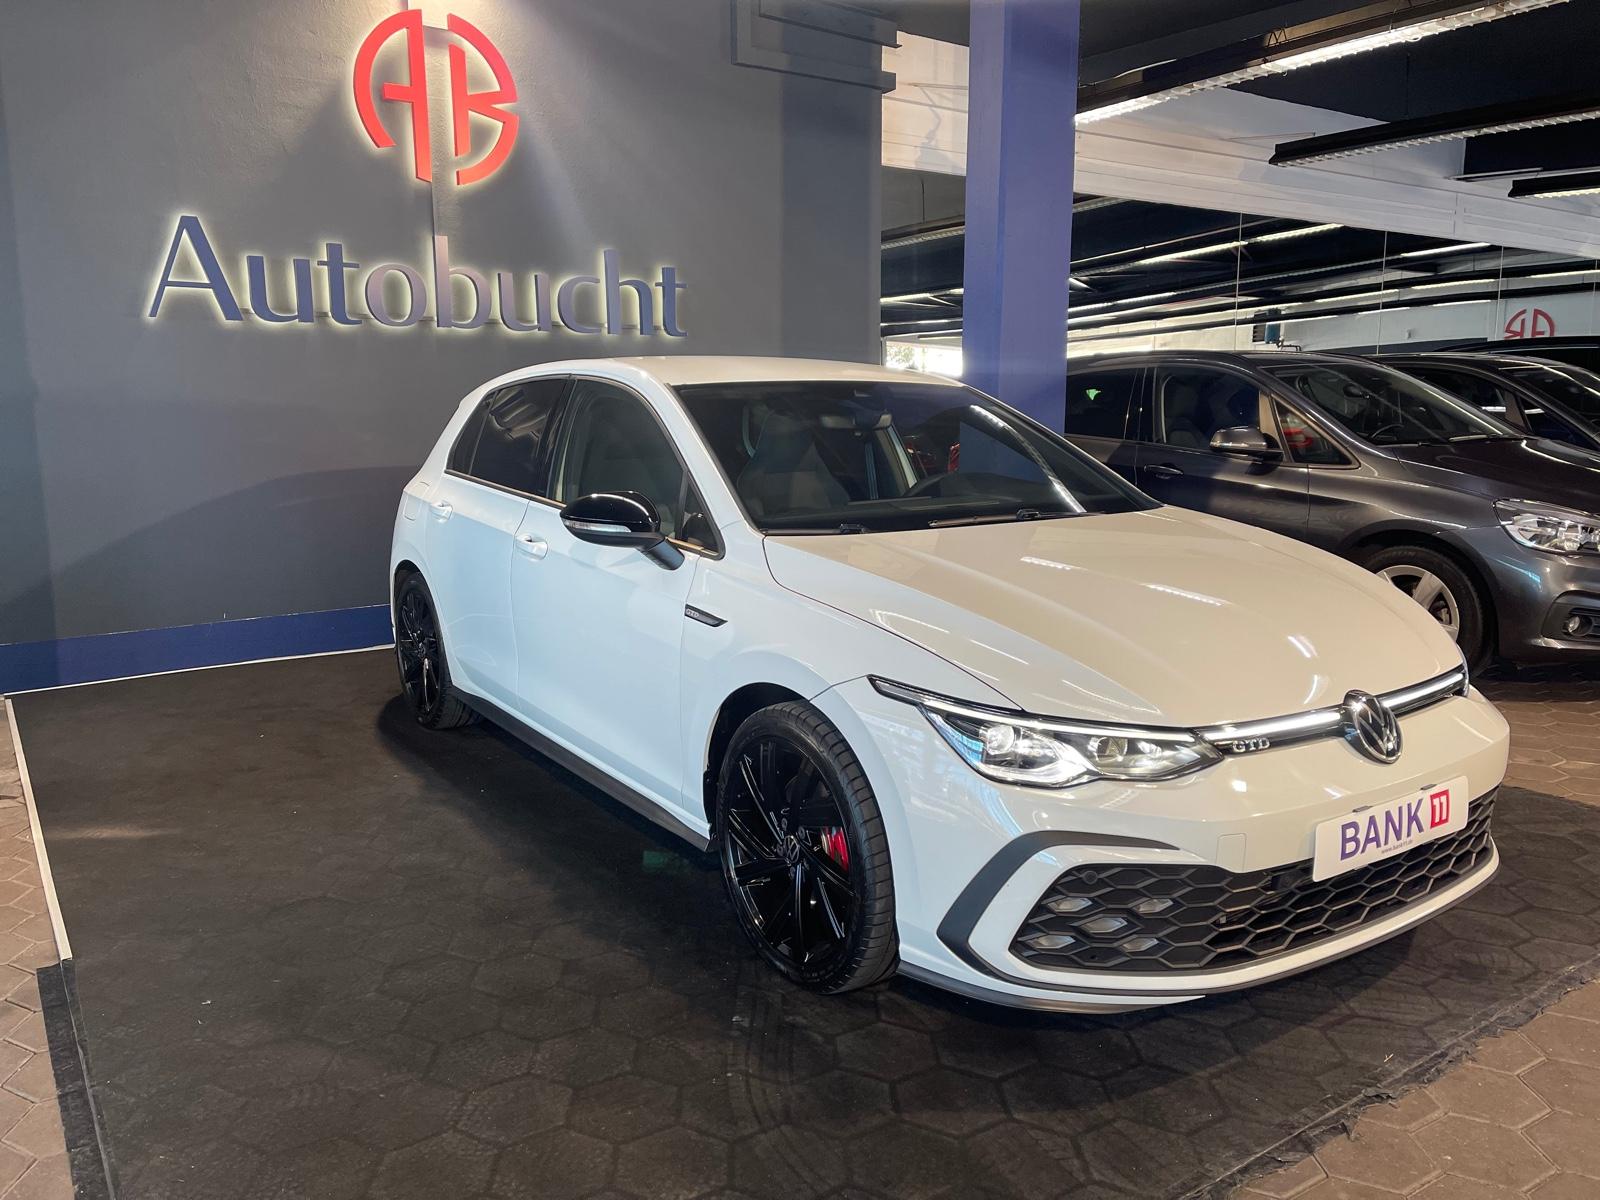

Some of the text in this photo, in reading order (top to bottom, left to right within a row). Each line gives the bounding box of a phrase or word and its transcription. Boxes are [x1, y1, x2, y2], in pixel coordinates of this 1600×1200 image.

[148, 214, 688, 337] Autobucht
[1232, 737, 1270, 753] GTD
[1340, 794, 1449, 861] BANK 11
